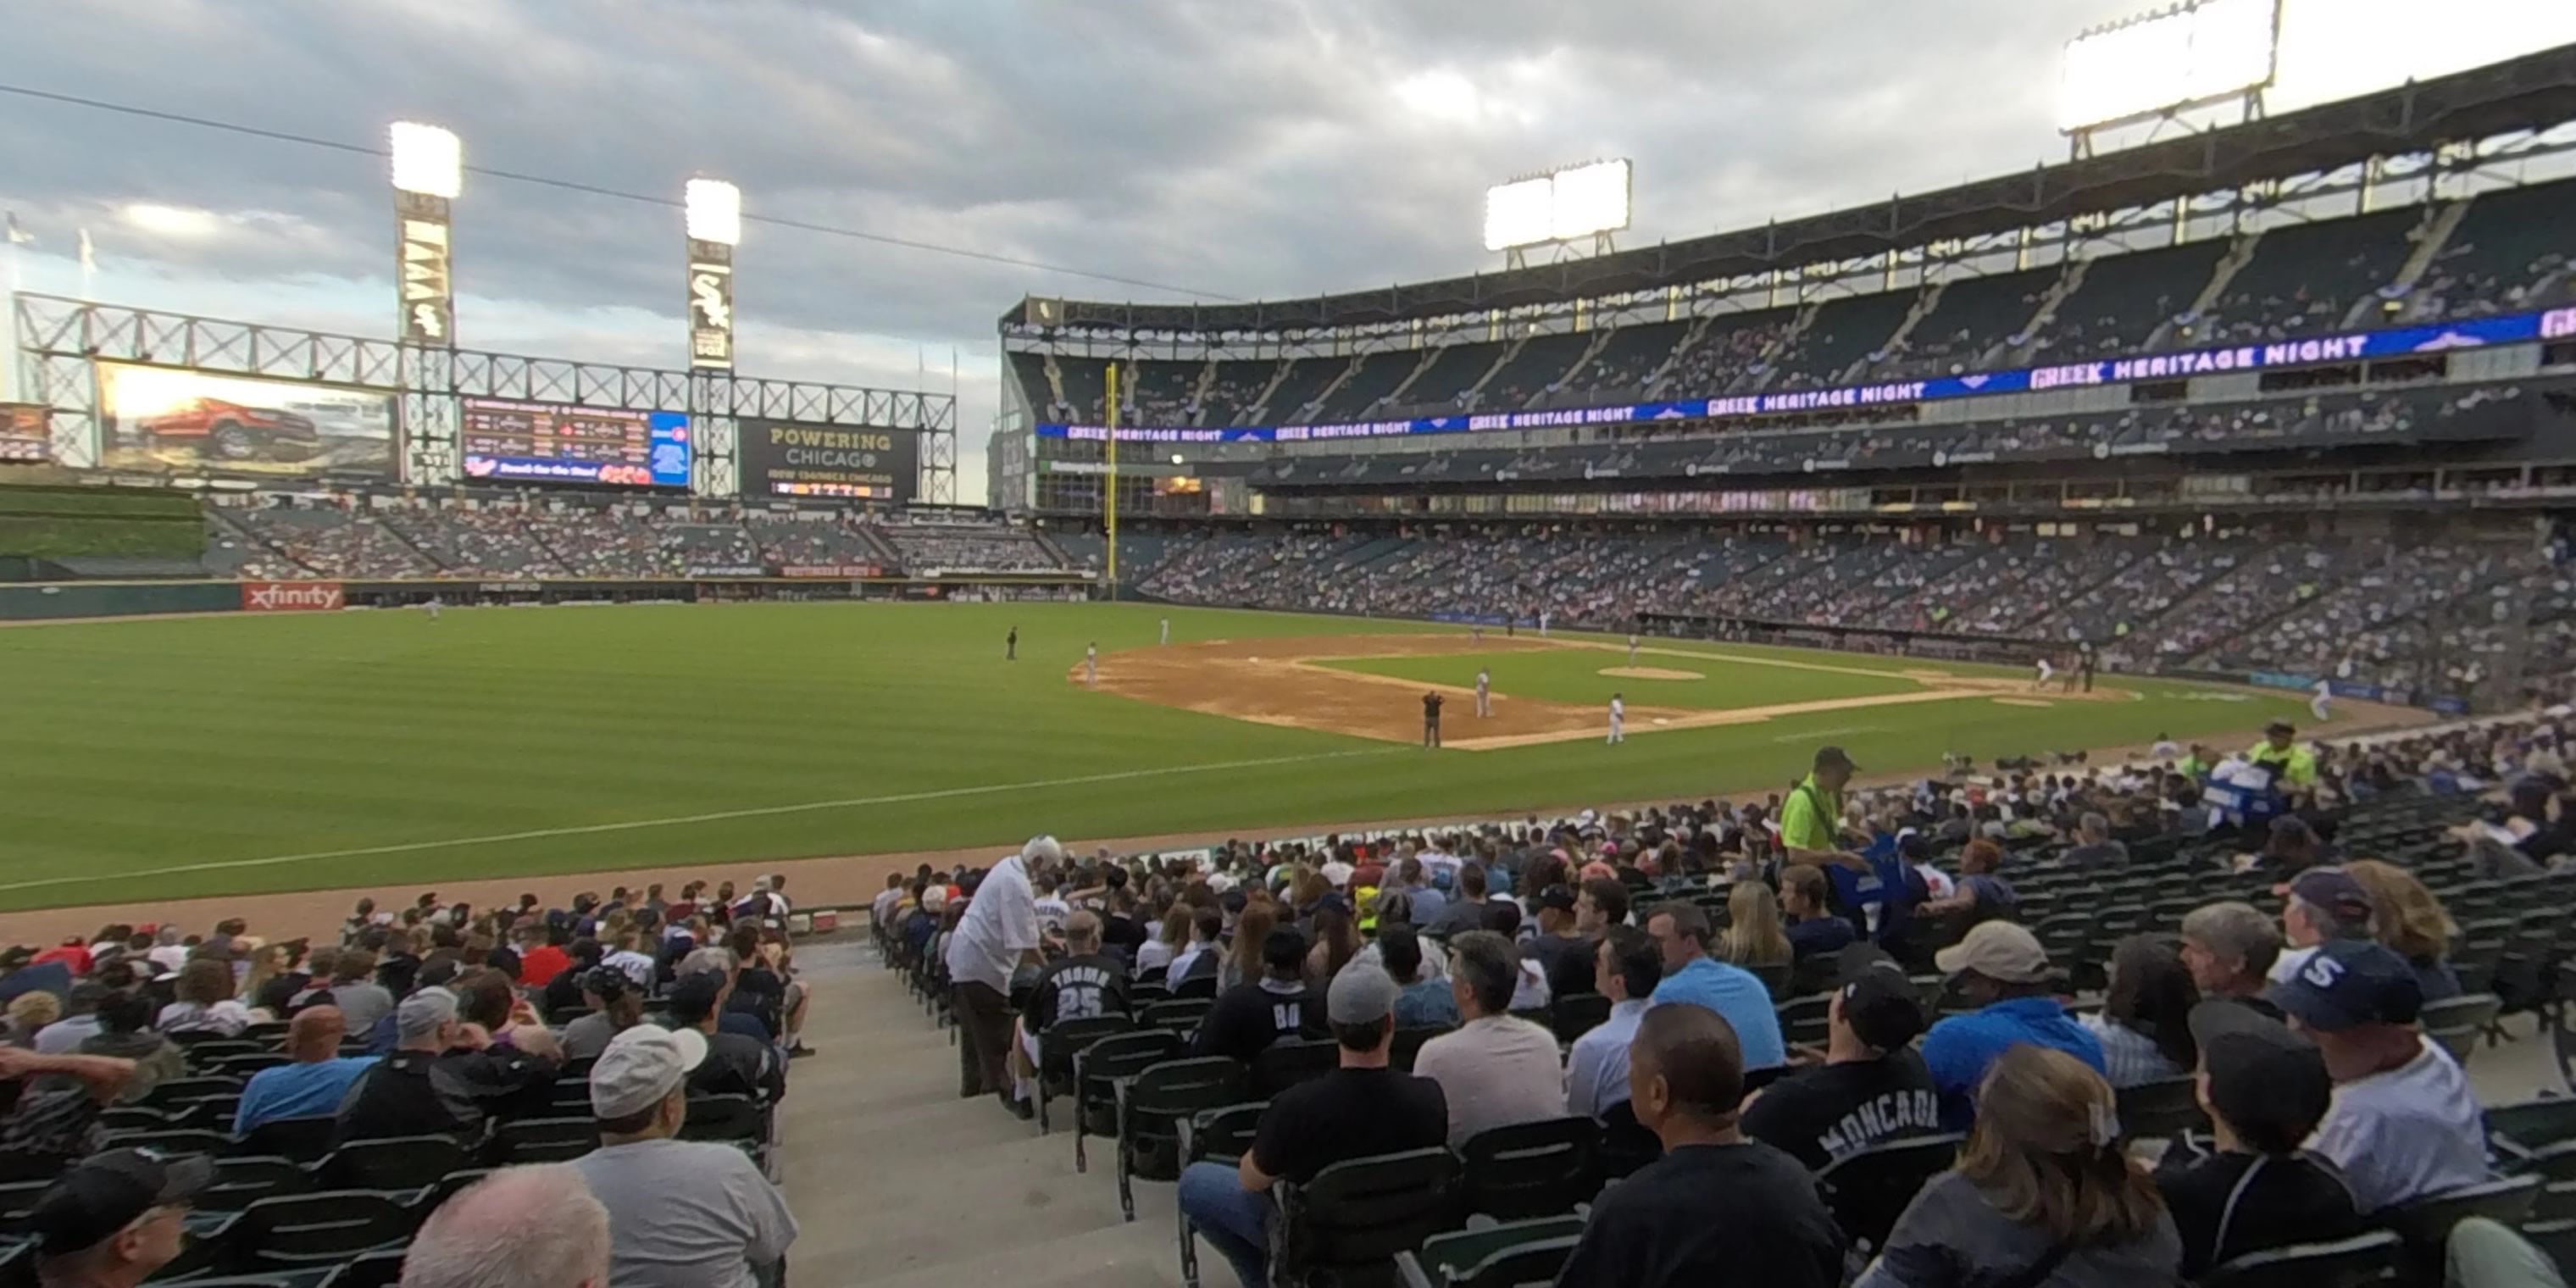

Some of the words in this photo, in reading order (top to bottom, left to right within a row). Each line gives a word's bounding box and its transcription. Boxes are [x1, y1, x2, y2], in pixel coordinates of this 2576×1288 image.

[2030, 362, 2105, 389] GREEK
[2114, 347, 2255, 379] HERITAGE
[2265, 336, 2368, 364] NIGHT
[1707, 396, 1758, 416] GREEK
[1764, 389, 1856, 411] HERITAGE
[1861, 382, 1925, 402] NIGHT
[1469, 414, 1508, 430] GREEK
[1513, 409, 1583, 426] HERITAGE
[1586, 406, 1635, 422] NIGHT
[770, 428, 891, 451] POWERING
[1068, 425, 1108, 441] GREEK
[1180, 430, 1222, 441] NIGHT
[1275, 426, 1308, 441] GREEK
[1313, 423, 1369, 437] HERITAGE
[1373, 420, 1411, 435] NIGHT
[786, 448, 876, 468] CHICAGO
[251, 585, 340, 609] xfinity
[2305, 956, 2345, 988] S
[1058, 985, 1102, 1019] 25
